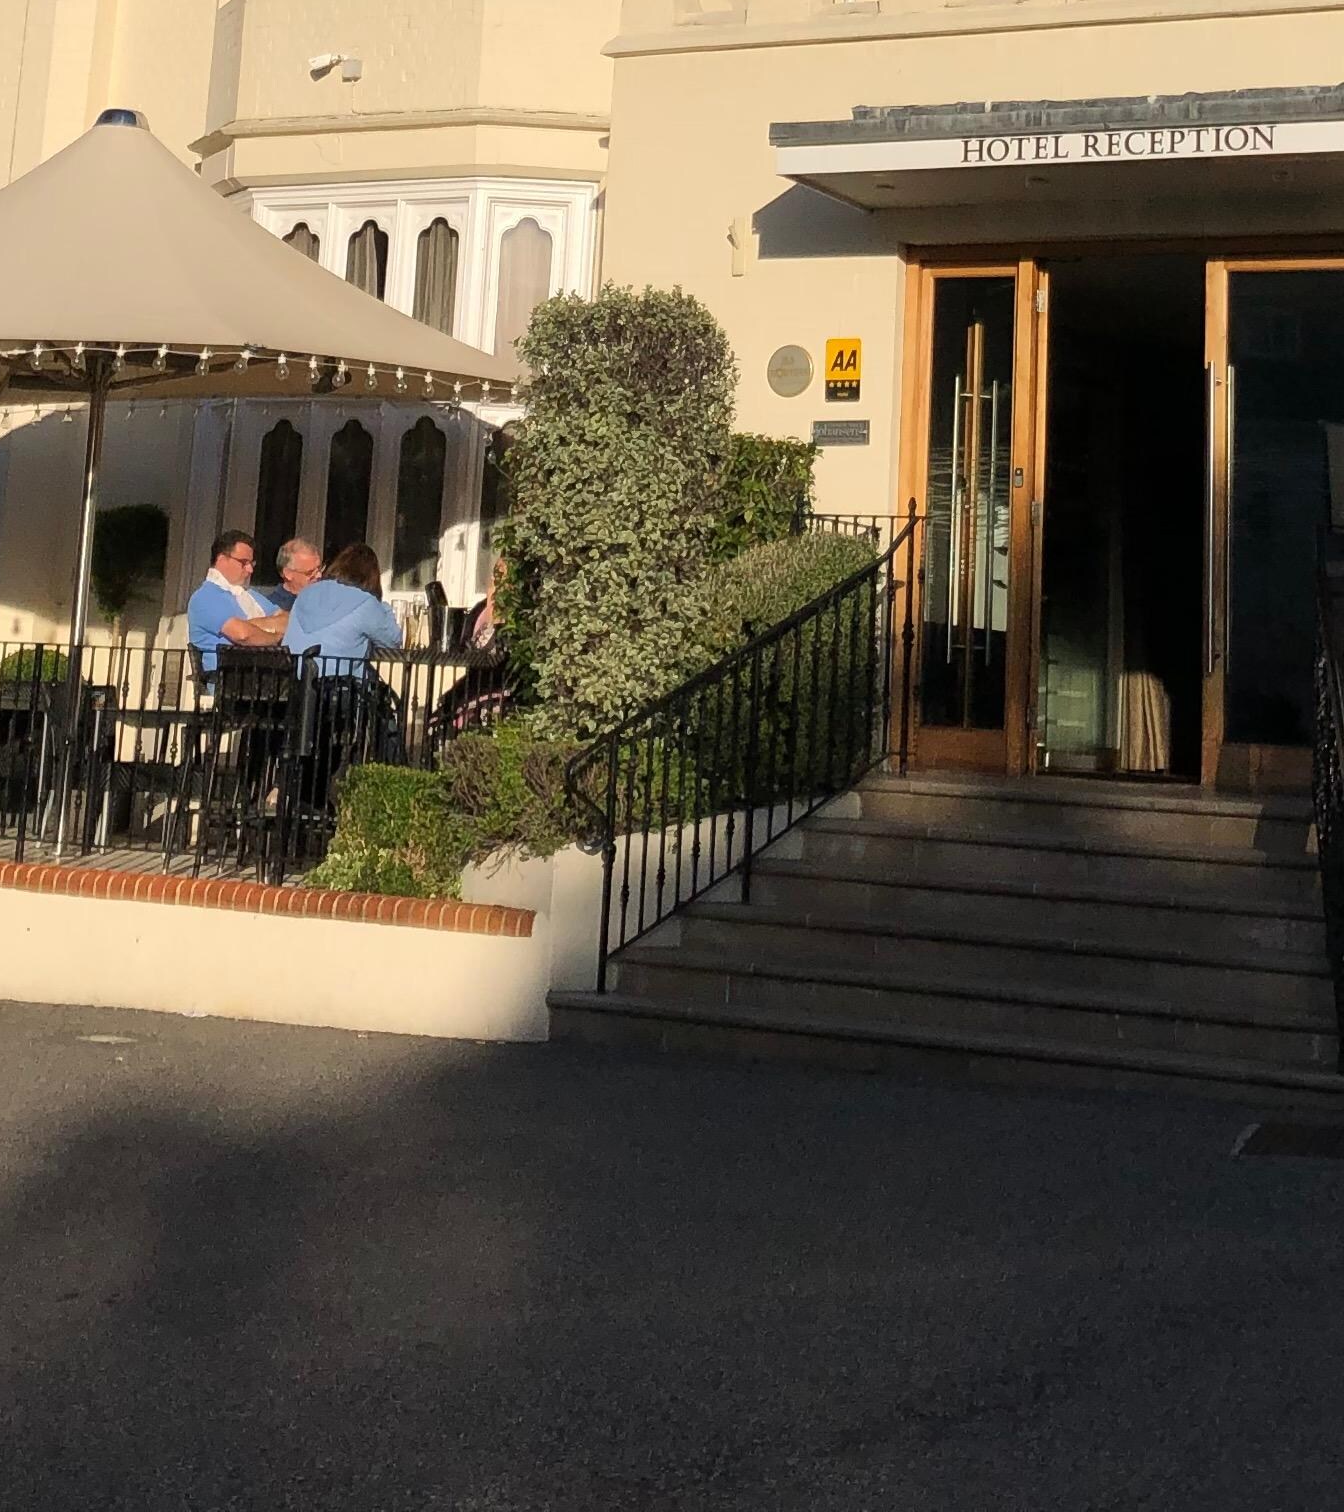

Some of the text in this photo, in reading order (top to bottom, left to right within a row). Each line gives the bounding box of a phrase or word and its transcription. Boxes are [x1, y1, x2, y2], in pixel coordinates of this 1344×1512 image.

[960, 125, 1277, 163] HOTEL RECEPTION
[830, 349, 857, 372] AA
